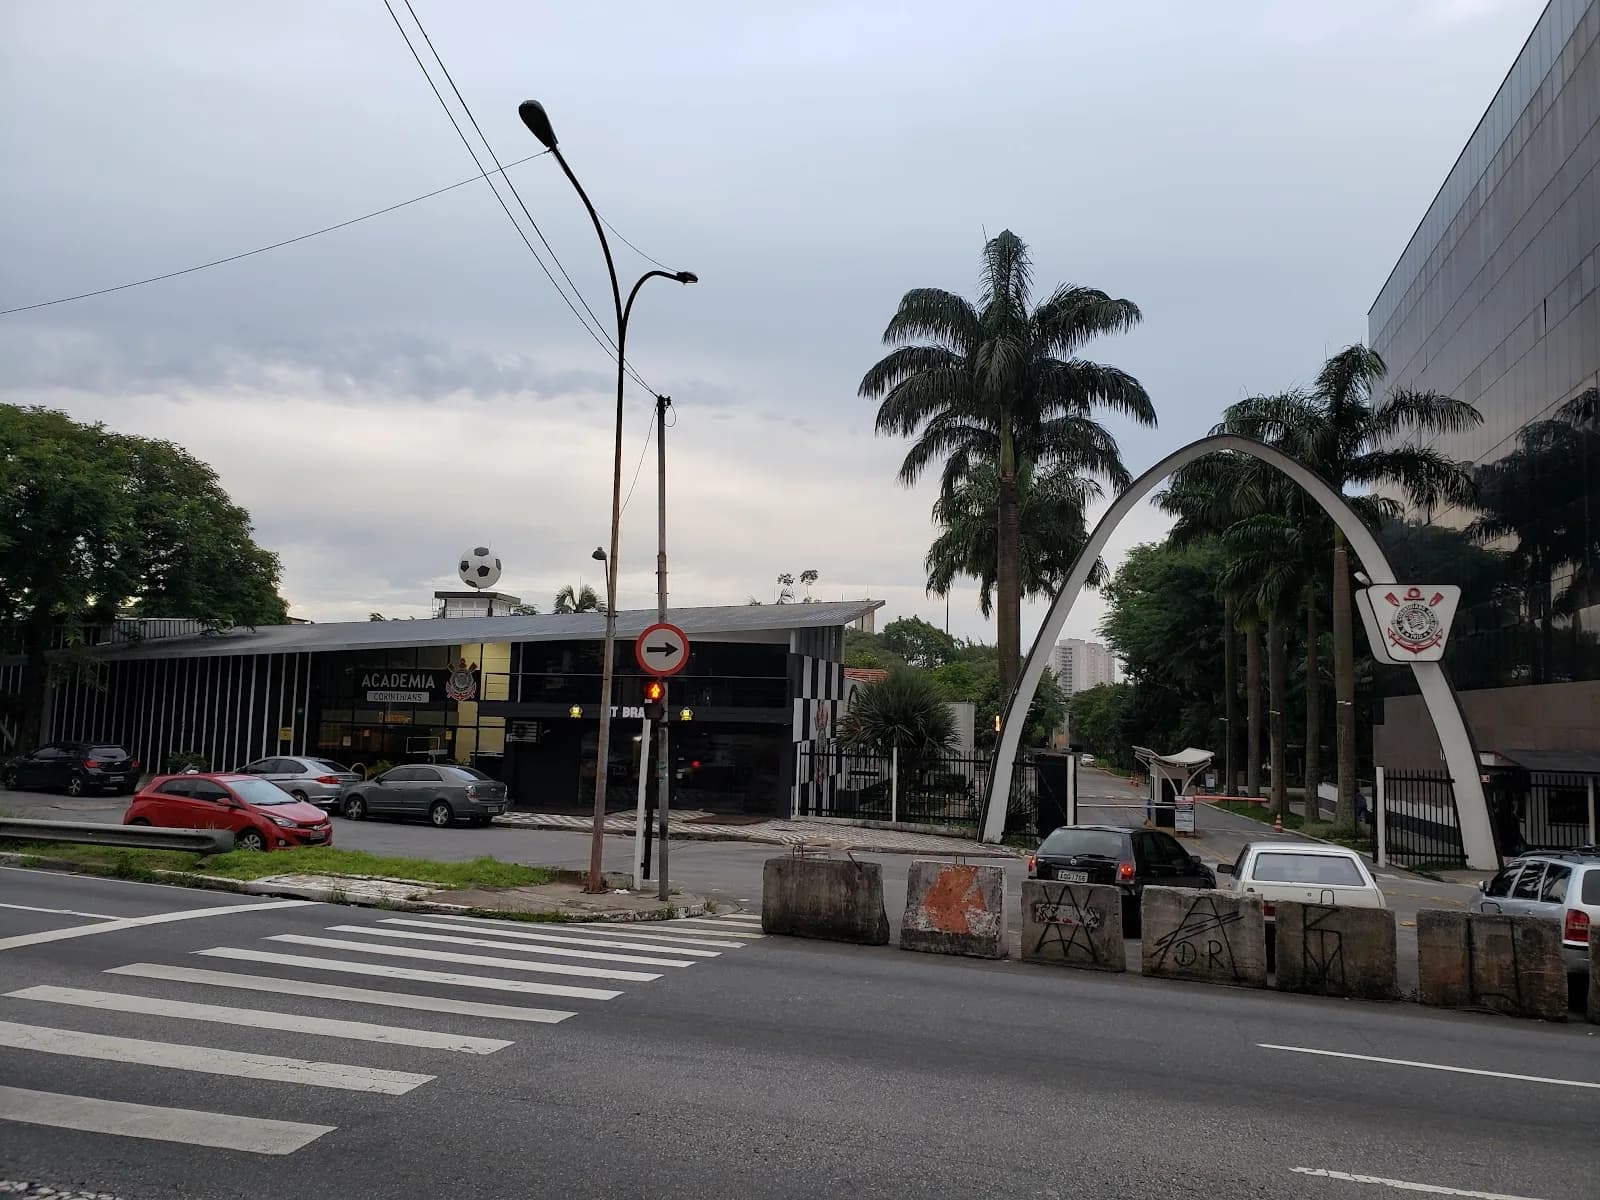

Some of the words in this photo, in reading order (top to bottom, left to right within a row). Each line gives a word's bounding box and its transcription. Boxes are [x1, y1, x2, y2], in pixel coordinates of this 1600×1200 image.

[361, 673, 435, 688] ACADEMIA
[373, 692, 423, 702] CORINTHIANS
[622, 706, 645, 718] BRA
